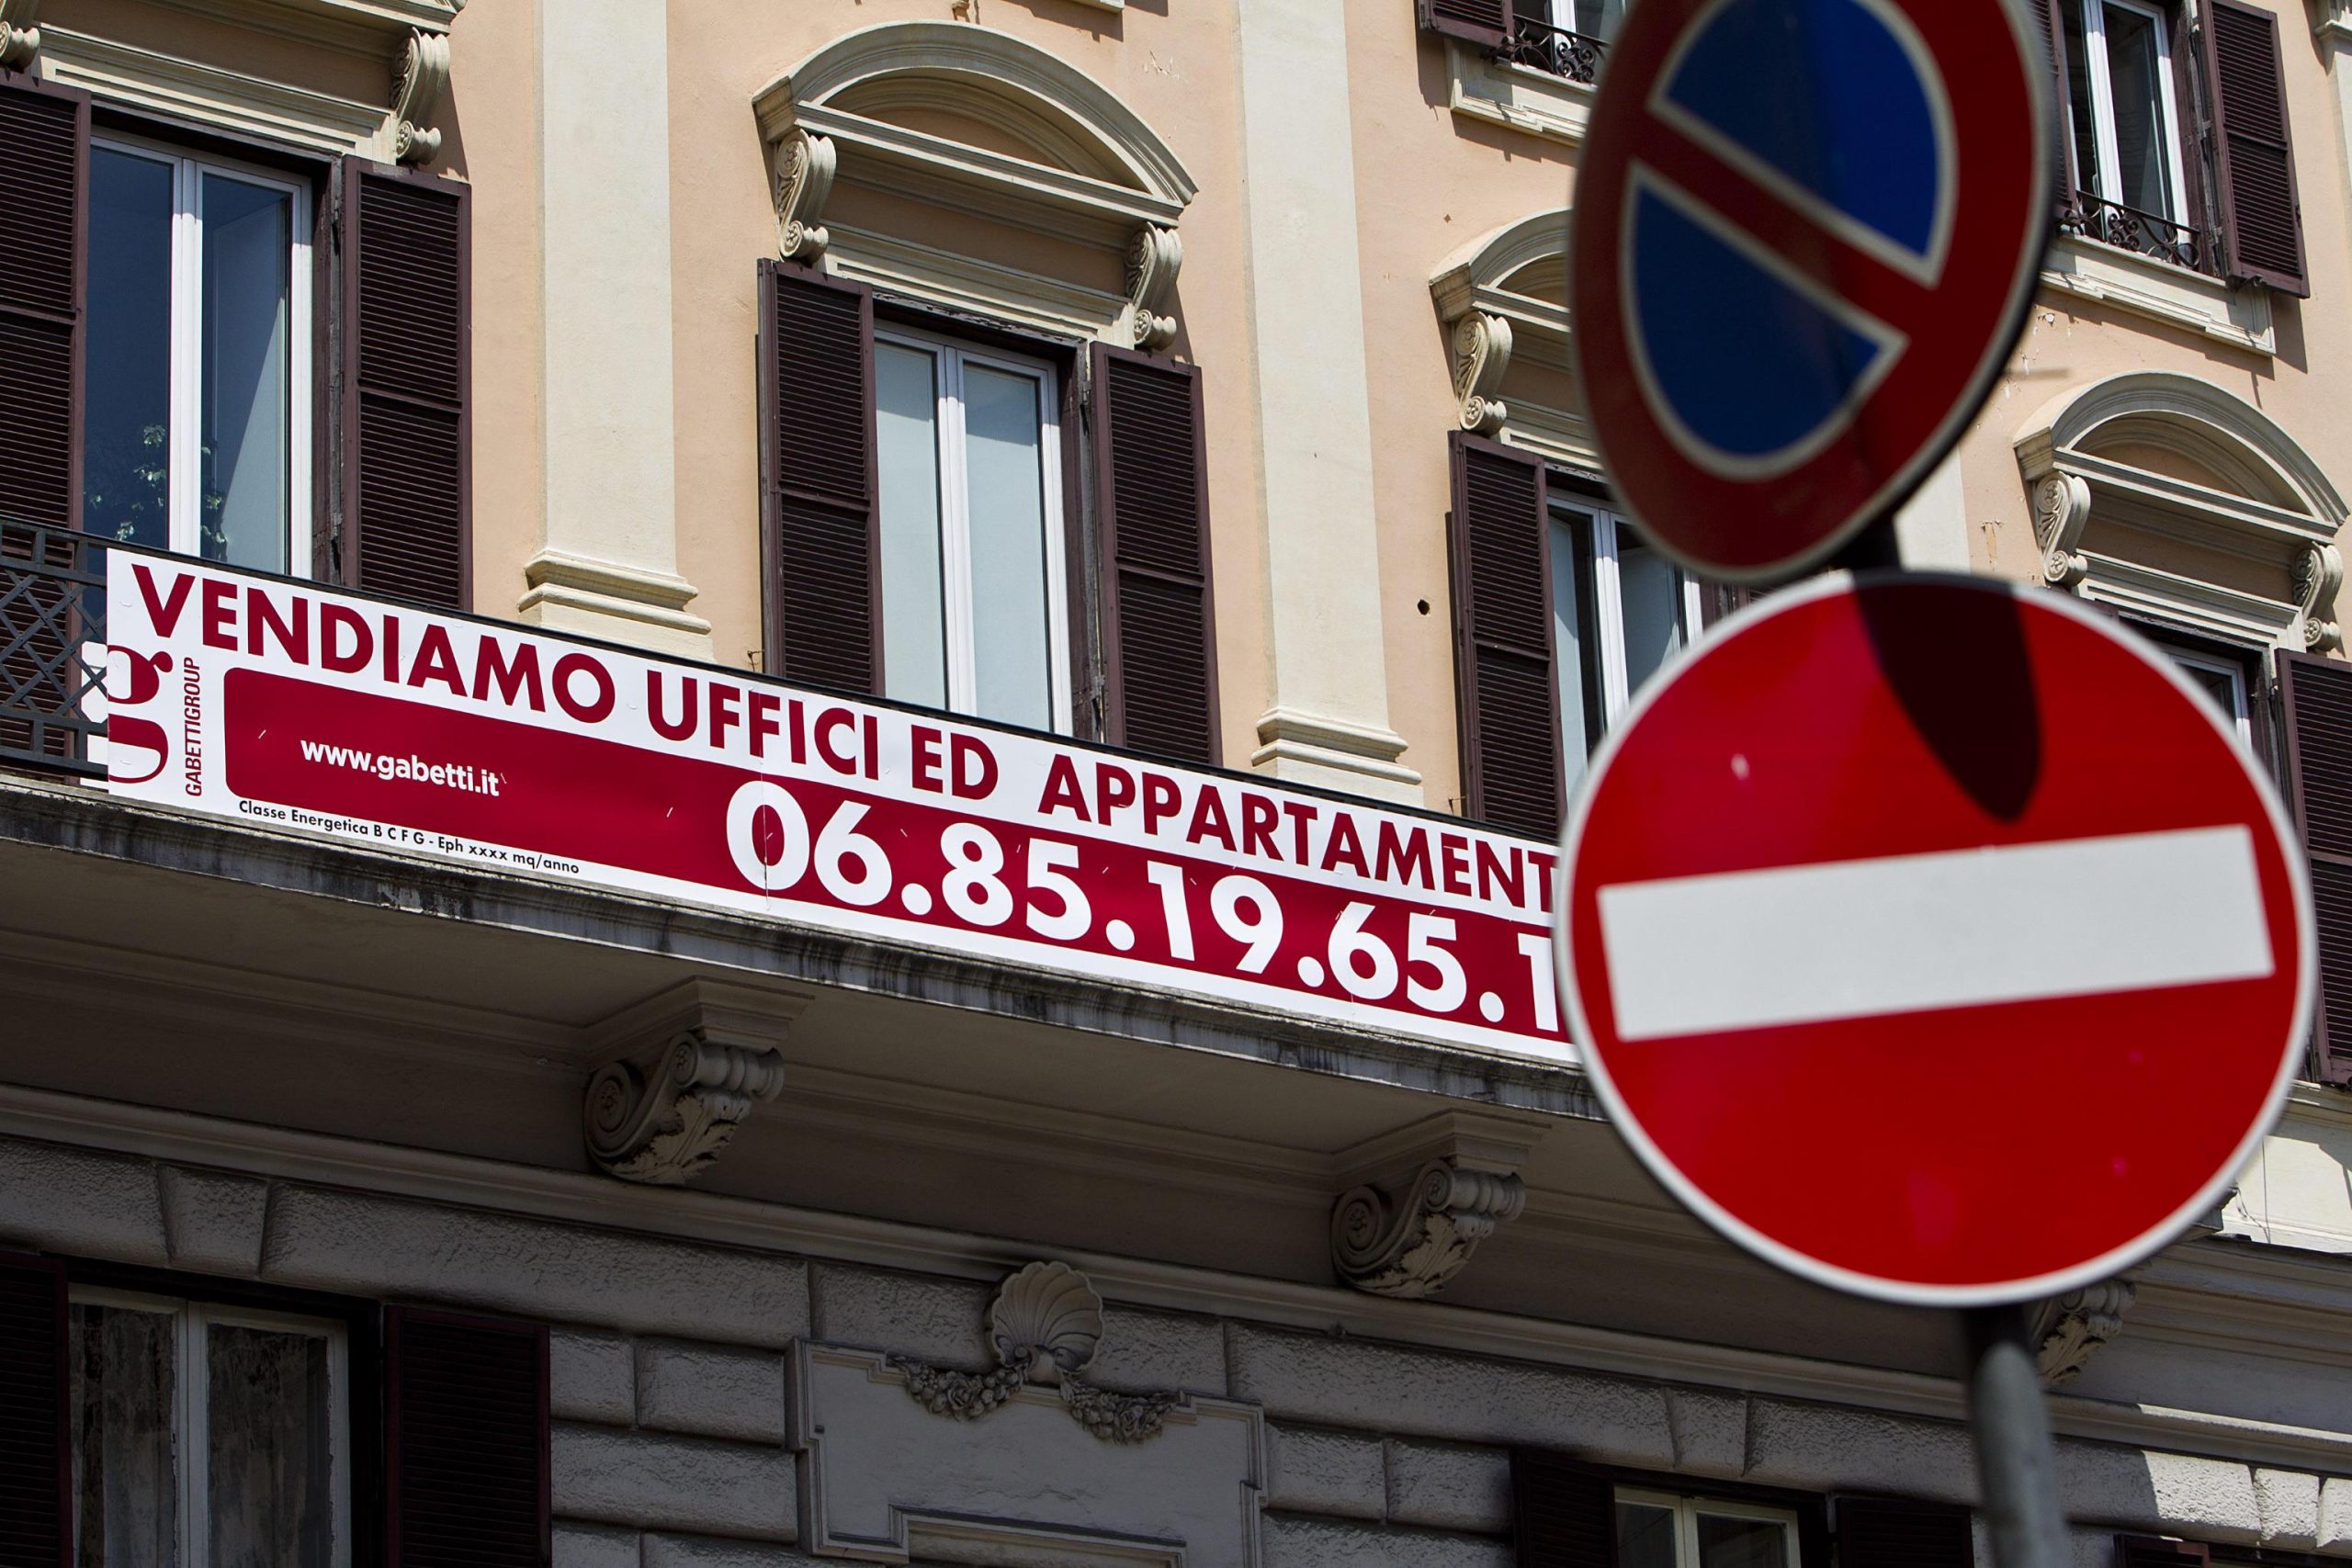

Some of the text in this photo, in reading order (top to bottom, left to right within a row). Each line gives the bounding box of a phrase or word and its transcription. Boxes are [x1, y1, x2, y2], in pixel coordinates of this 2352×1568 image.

[130, 563, 616, 723] VENDIAMO
[647, 670, 879, 781] UFFICI
[910, 724, 999, 800] ED
[184, 657, 203, 797] GABETTIGROUP
[239, 800, 286, 819] Classe
[291, 809, 368, 834] Energetica
[374, 825, 382, 837] B
[388, 828, 396, 840] C
[401, 829, 408, 841] F
[413, 831, 424, 844] G
[438, 836, 463, 853] Eph
[469, 845, 507, 860] xxxx
[513, 853, 579, 874] mq/anno
[300, 739, 501, 797] www.gabetti.it
[726, 780, 1558, 1032] 06.85.19.65.1
